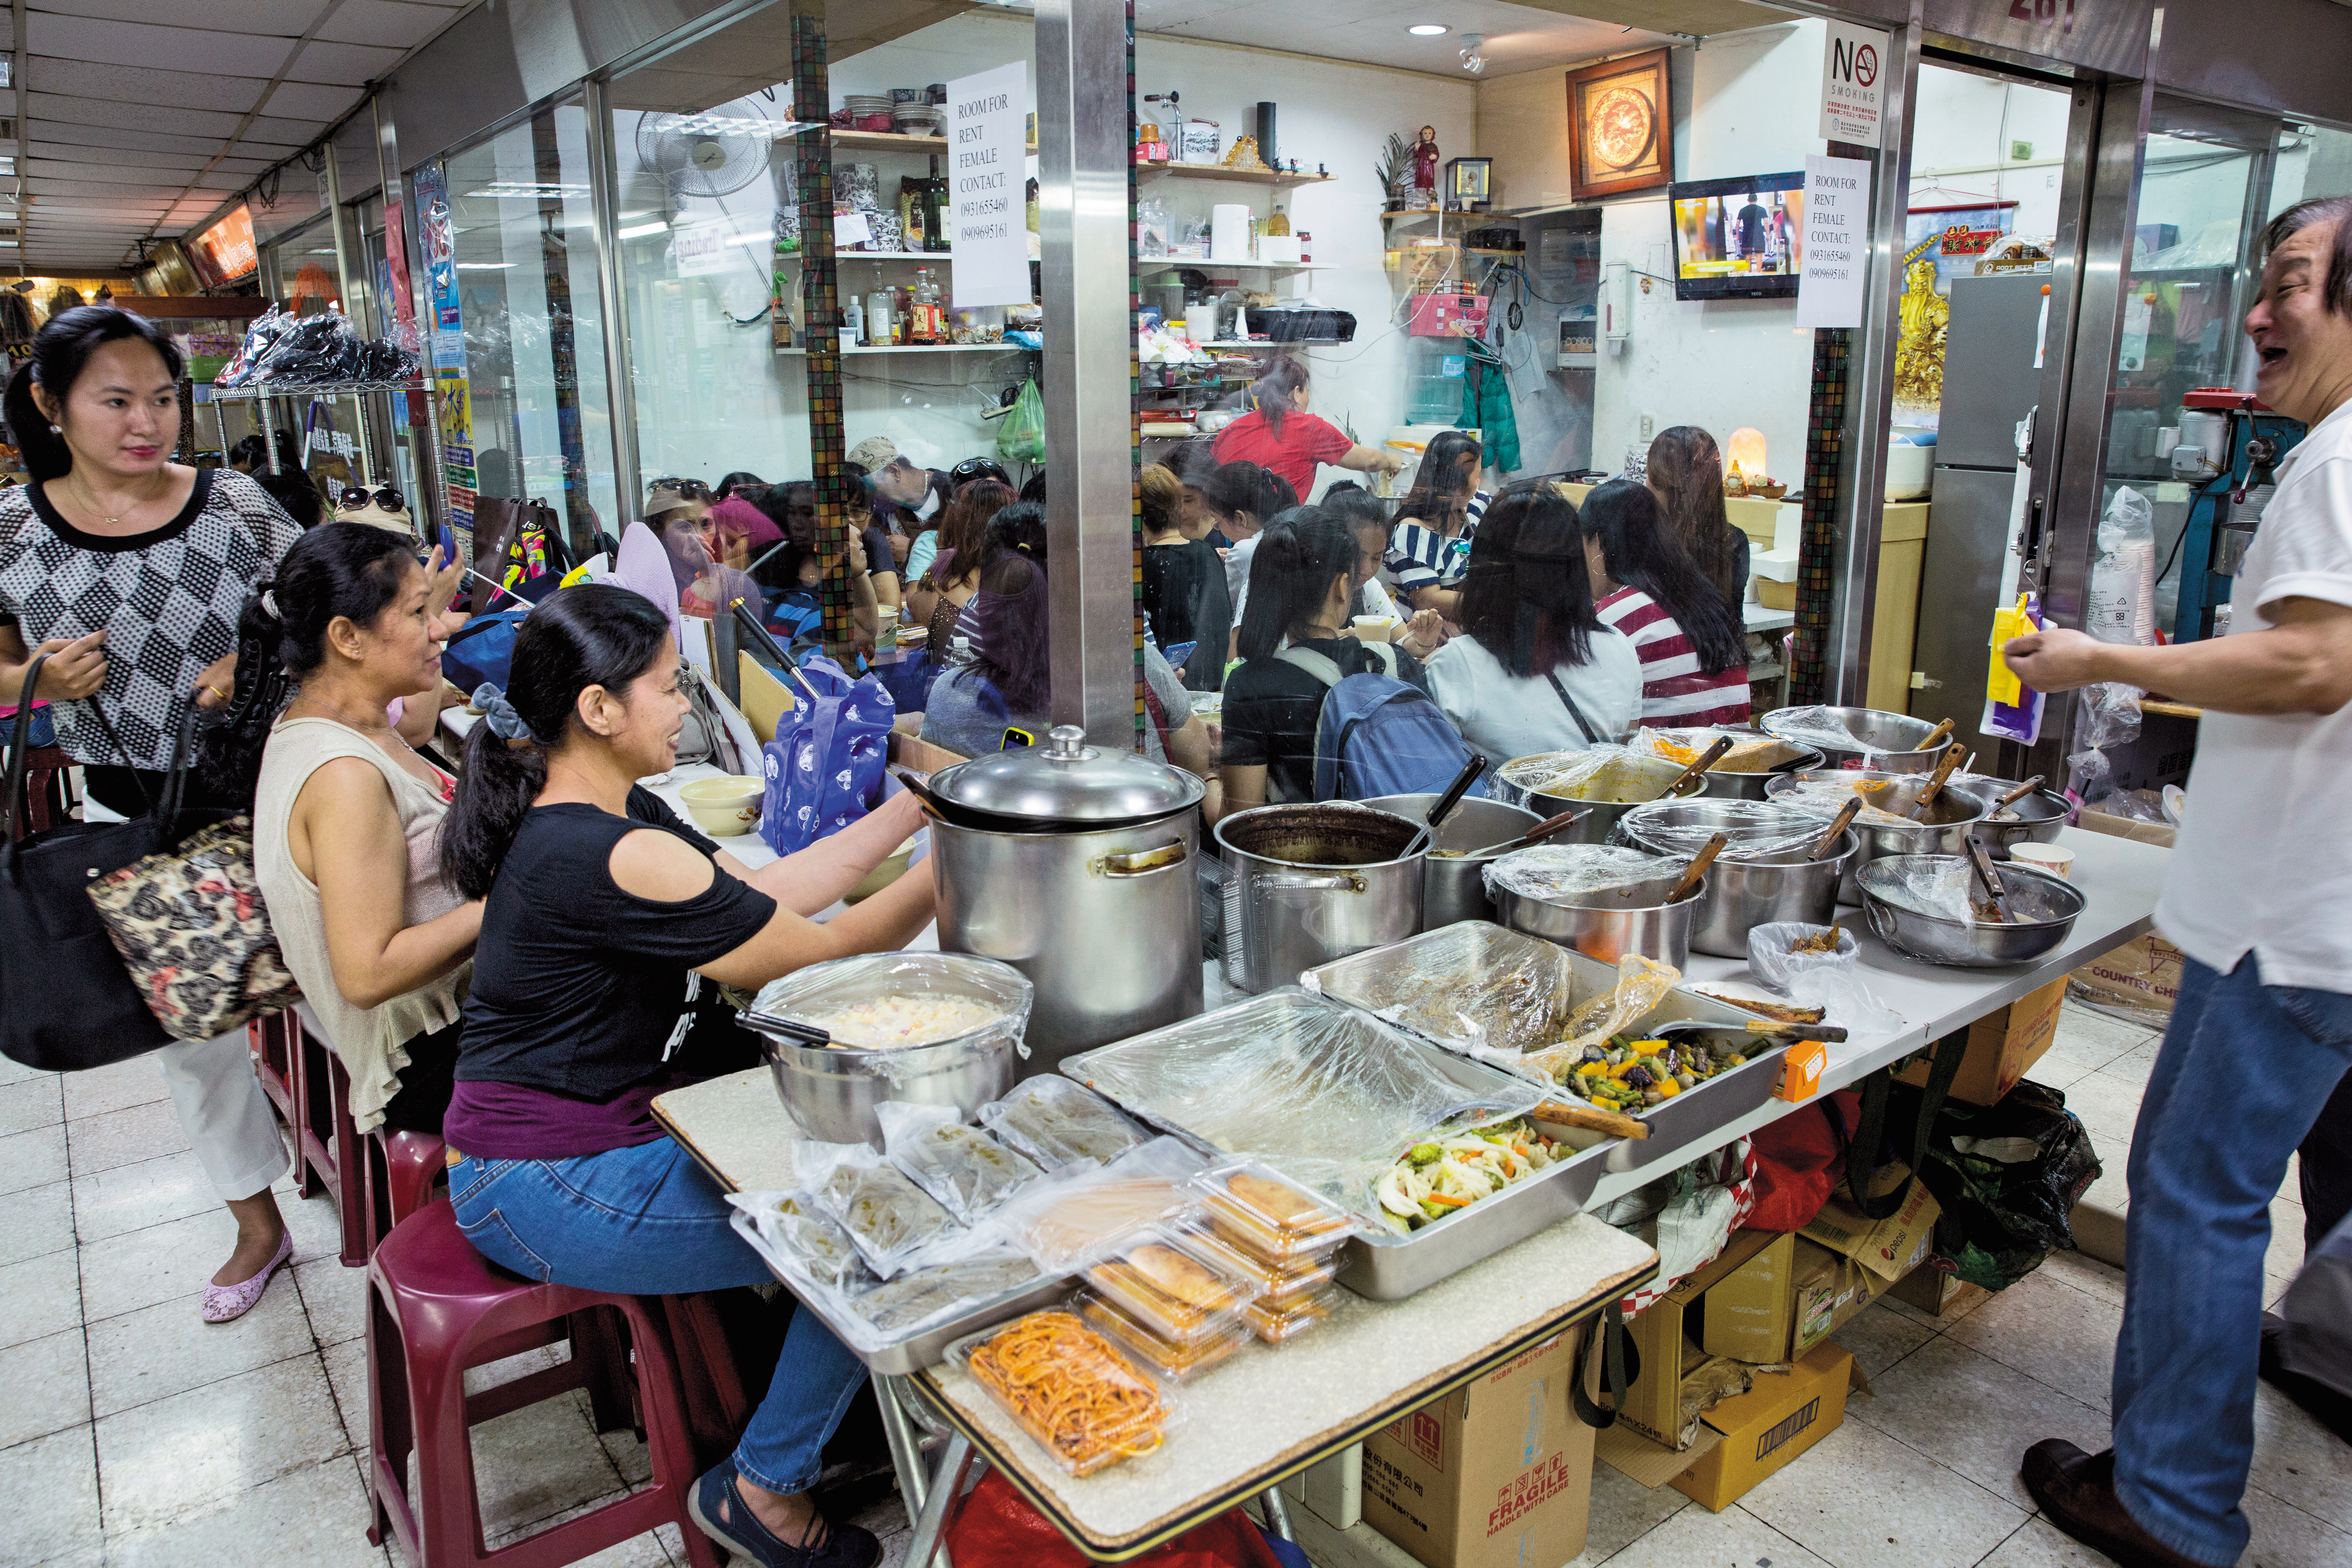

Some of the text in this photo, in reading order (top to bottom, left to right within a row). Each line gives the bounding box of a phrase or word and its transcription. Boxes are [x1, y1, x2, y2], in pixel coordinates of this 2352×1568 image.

[1833, 38, 1878, 87] NO
[1831, 85, 1875, 102] SMOKING
[958, 94, 1009, 119] ROOM FOR
[959, 126, 983, 144] RENT
[960, 148, 998, 169] FEMALE
[960, 172, 1006, 193] CONTACT:
[1815, 176, 1857, 190] ROOM FOR
[961, 197, 1008, 217] 0931655460
[1814, 194, 1836, 207] RENT
[1813, 213, 1845, 226] FEMALE
[962, 223, 1007, 241] 0909695161
[1811, 232, 1851, 245] CONTACT:
[1810, 250, 1850, 263] 0931655460
[1809, 267, 1849, 281] 0909695161
[2093, 967, 2152, 990] COUNTRY
[1890, 1229, 1907, 1253] pepsi
[1363, 1446, 1423, 1497] 股份有限公司
[1489, 1464, 1568, 1527] FRAGILE
[1487, 1479, 1569, 1538] HANDLE WITH CARE
